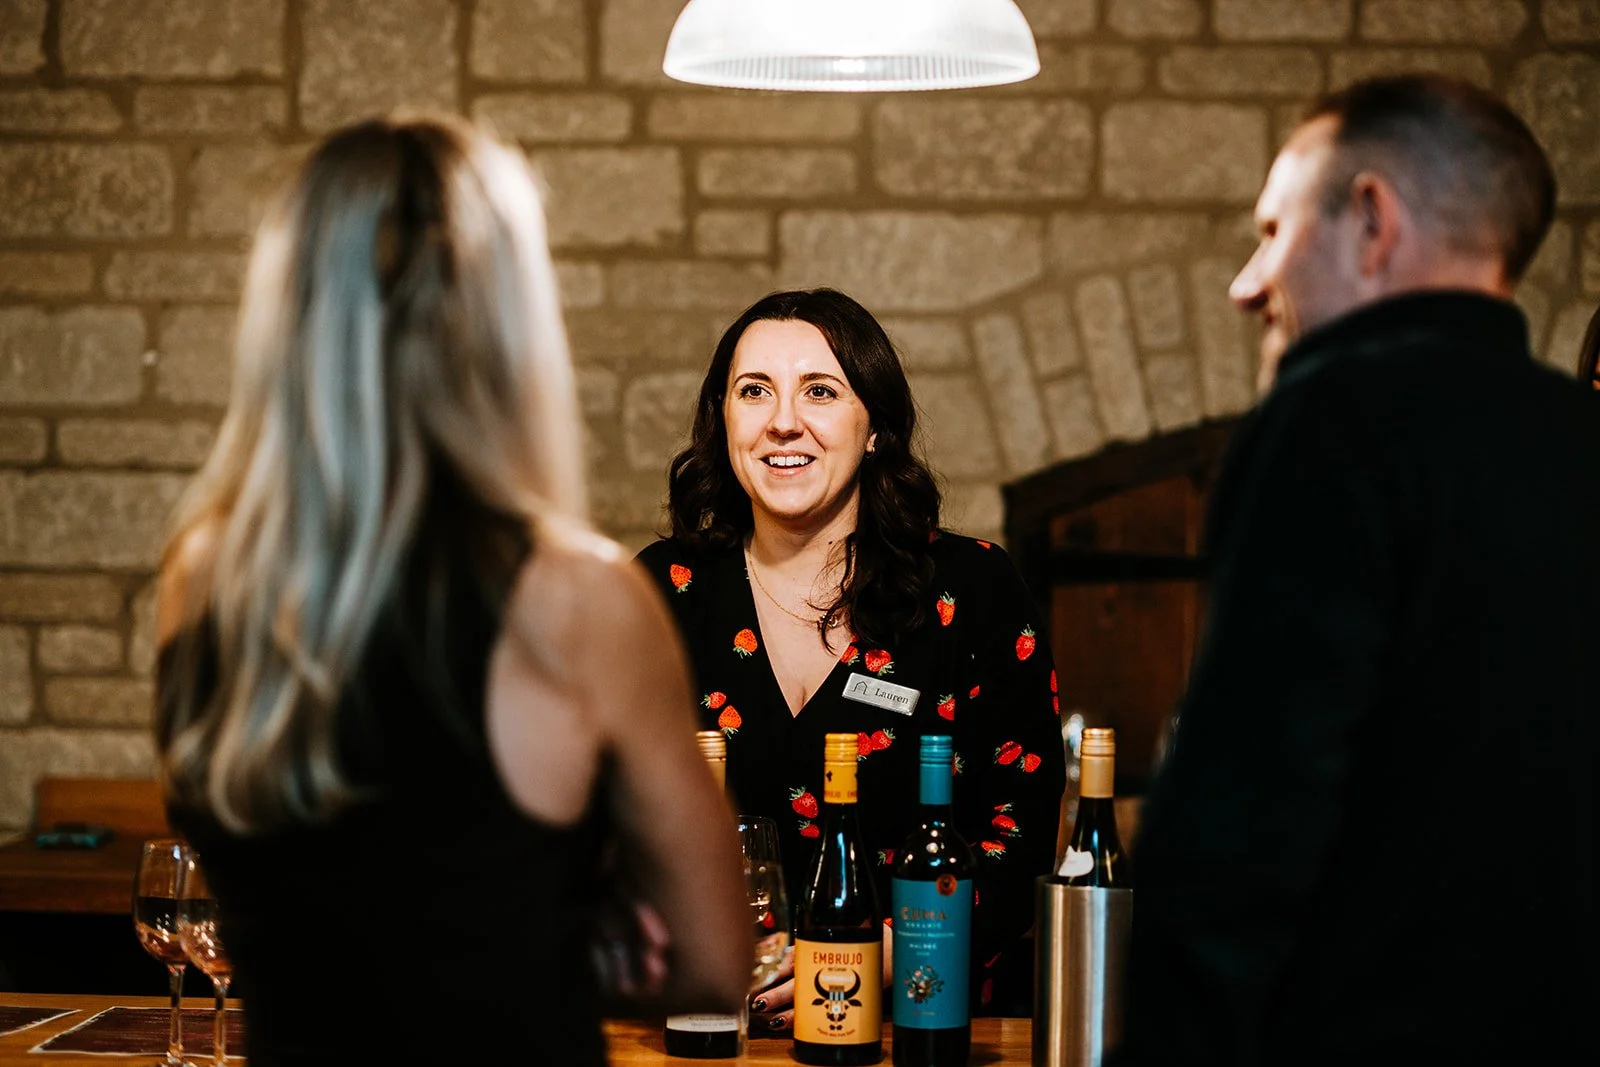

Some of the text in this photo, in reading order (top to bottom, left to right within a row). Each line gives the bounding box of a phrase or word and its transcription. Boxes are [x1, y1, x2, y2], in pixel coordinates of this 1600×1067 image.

[875, 688, 909, 704] Lauren
[901, 906, 947, 920] CUMA
[813, 952, 863, 965] EMBRUJO
